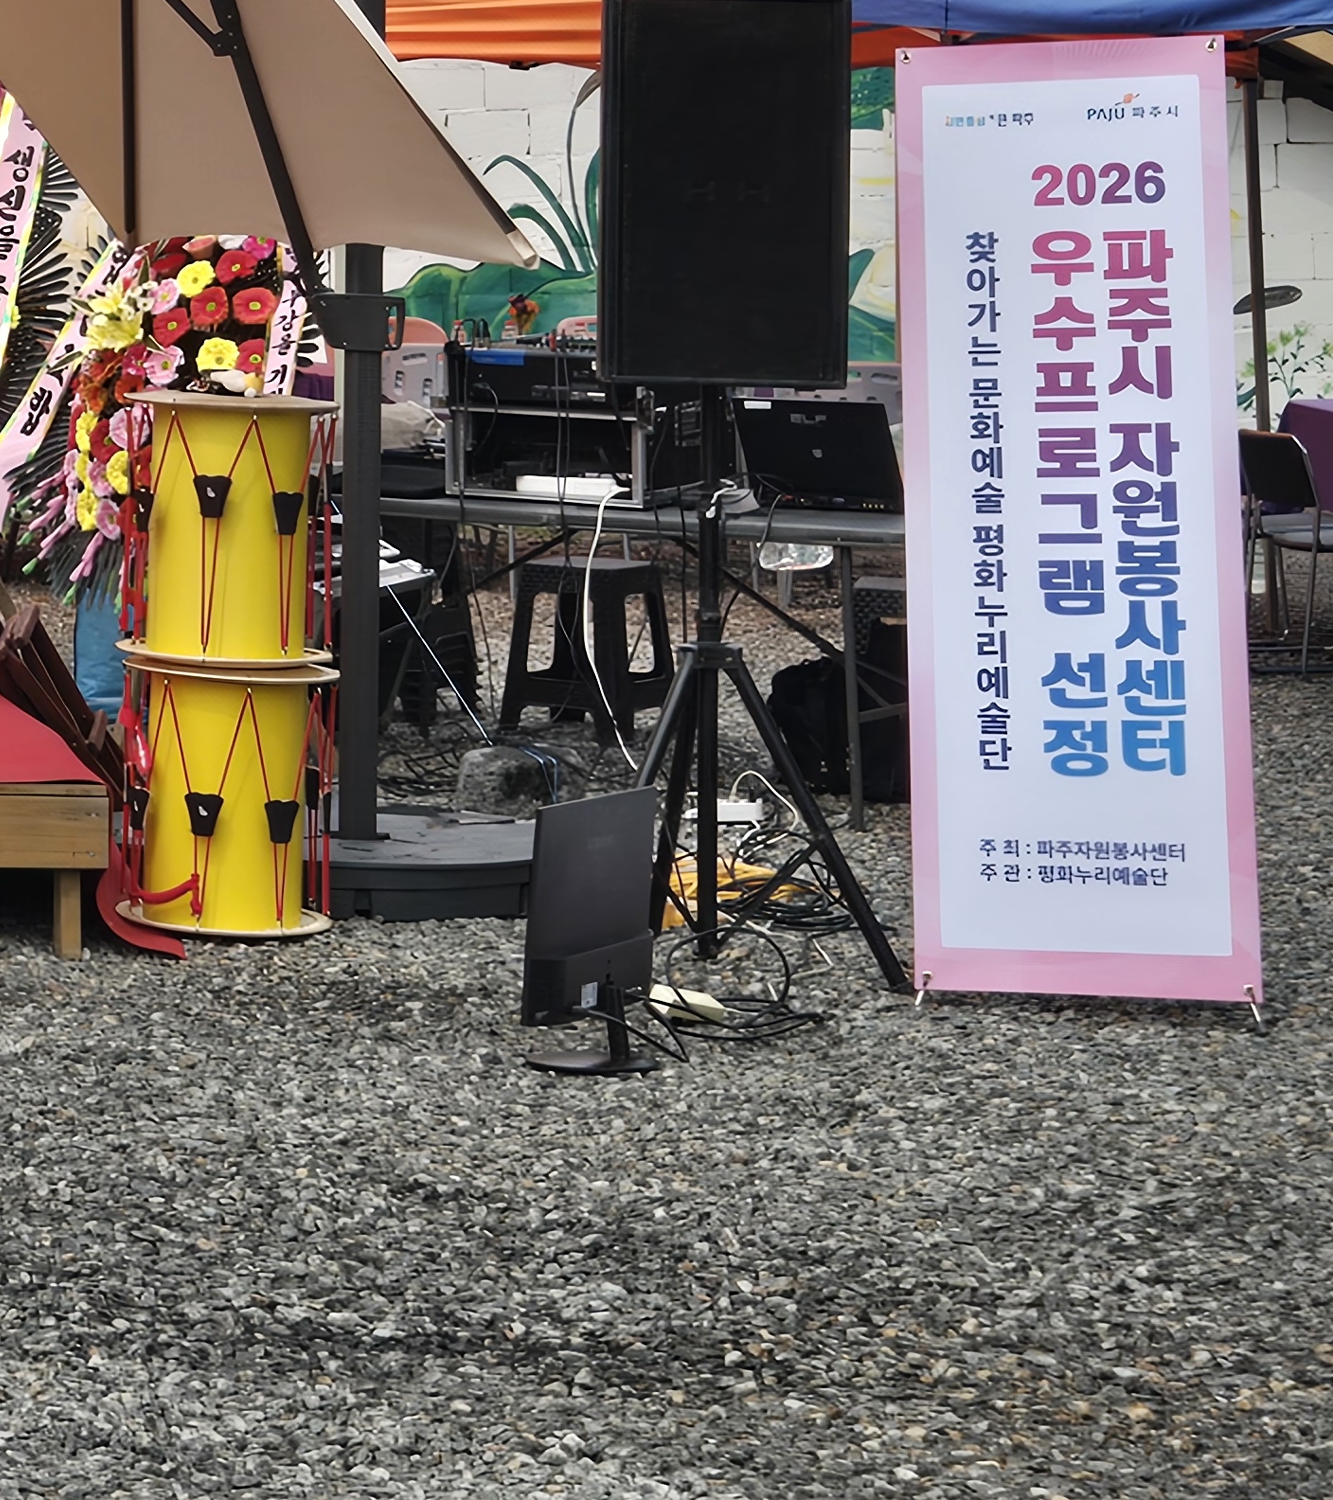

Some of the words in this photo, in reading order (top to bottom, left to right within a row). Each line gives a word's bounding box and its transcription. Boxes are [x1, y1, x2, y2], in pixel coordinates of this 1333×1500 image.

[1086, 107, 1125, 122] PAJU
[1031, 160, 1167, 207] 2026
[964, 231, 1000, 368] 찾아가는
[1100, 228, 1175, 402] 파주시
[968, 380, 1005, 515] 문화예술
[1030, 230, 1106, 618] 우수프로그램
[972, 522, 1012, 773] 평화누리예술단
[1109, 420, 1189, 777] 자원봉사센터
[1040, 650, 1110, 778] 선정
[1037, 840, 1187, 863] 파주자원봉사센터
[1037, 864, 1169, 887] 평화누리예술단
